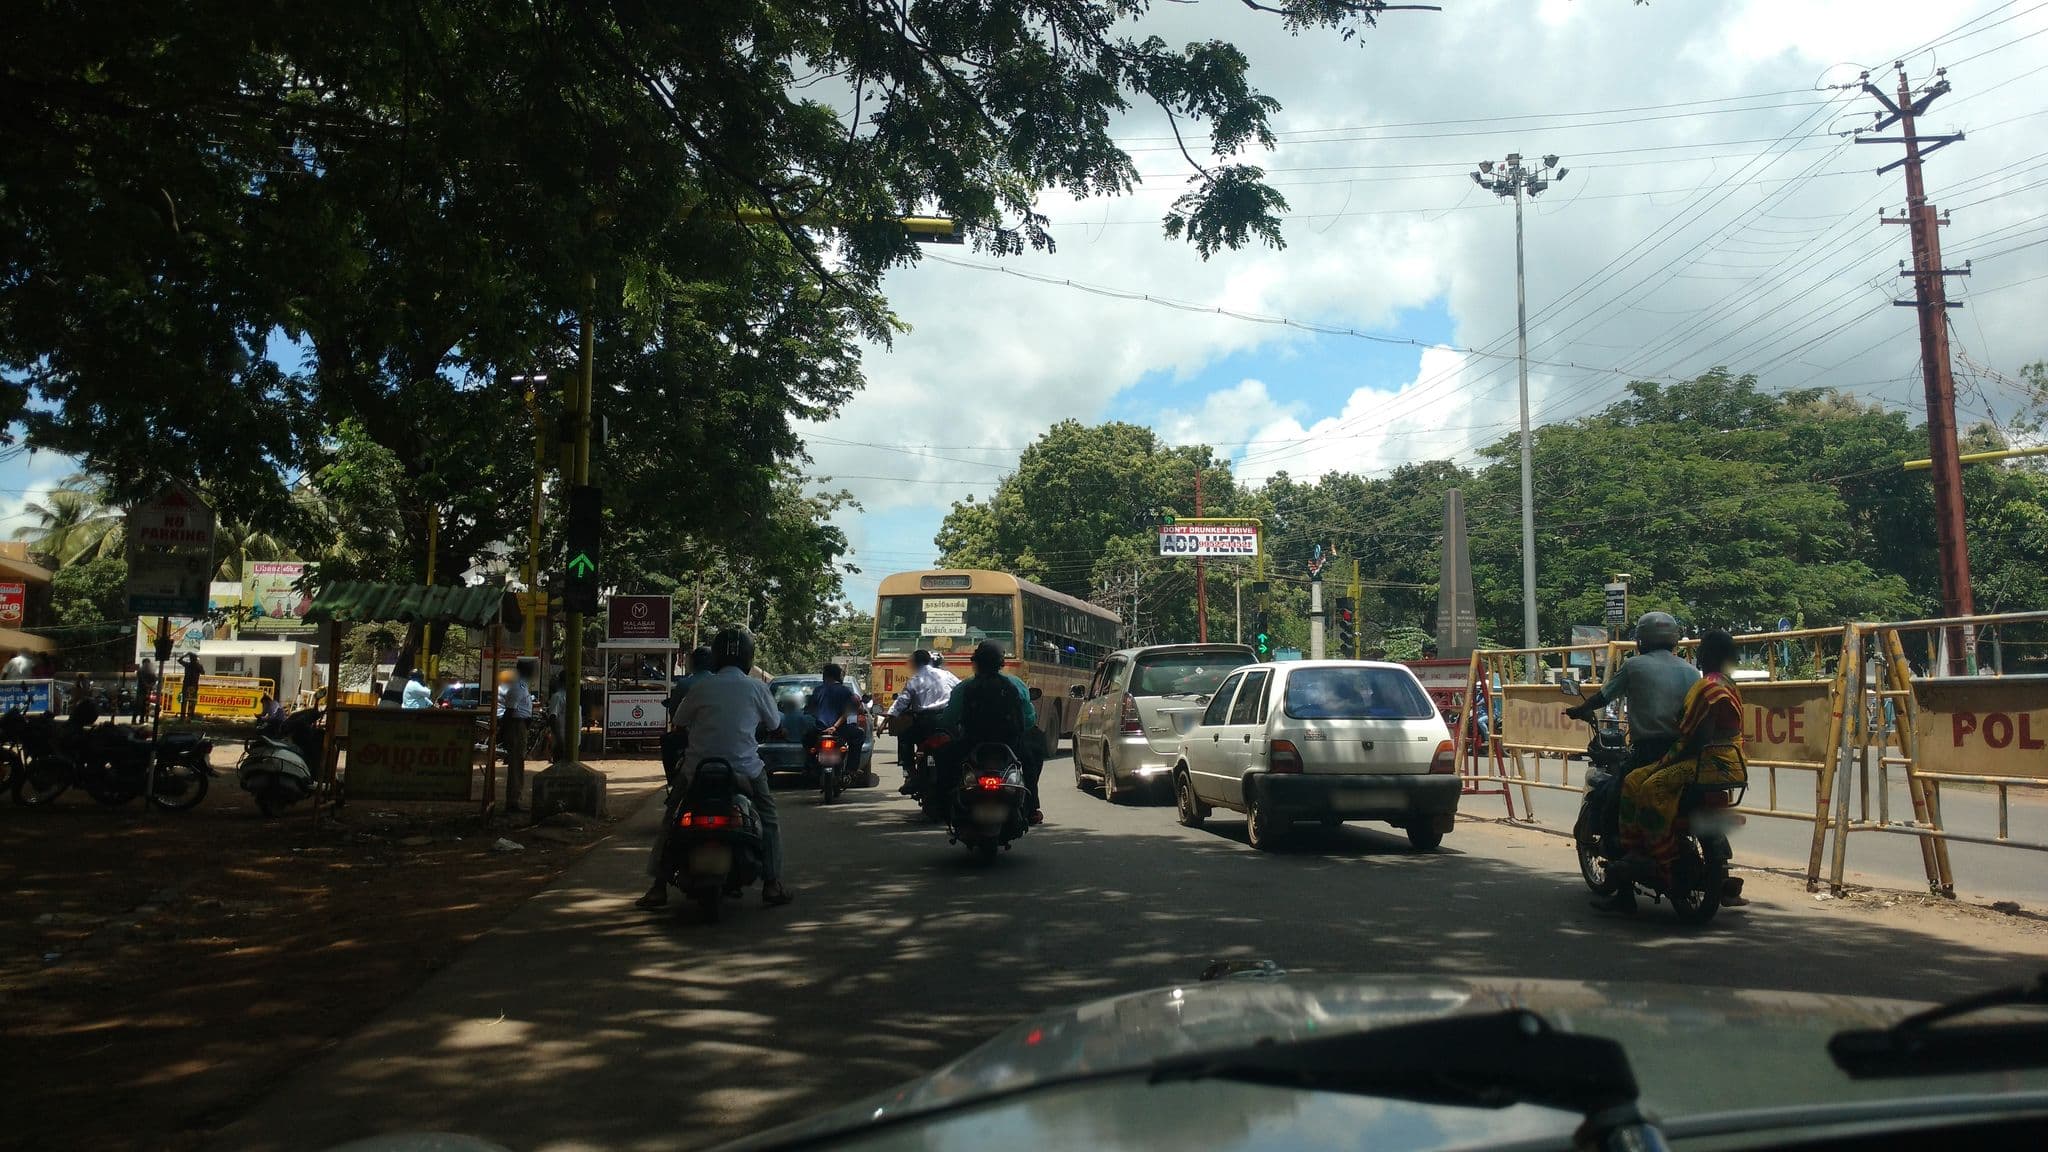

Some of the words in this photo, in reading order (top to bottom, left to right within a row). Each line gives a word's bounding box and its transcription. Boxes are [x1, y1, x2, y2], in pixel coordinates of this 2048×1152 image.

[164, 516, 184, 527] NO
[141, 528, 208, 542] PARKING
[1163, 526, 1188, 534] DON'T
[1189, 526, 1227, 534] DRUNKEN
[1229, 526, 1253, 534] DRIVE
[1163, 535, 1200, 552] ADD
[1206, 535, 1253, 552] HERE
